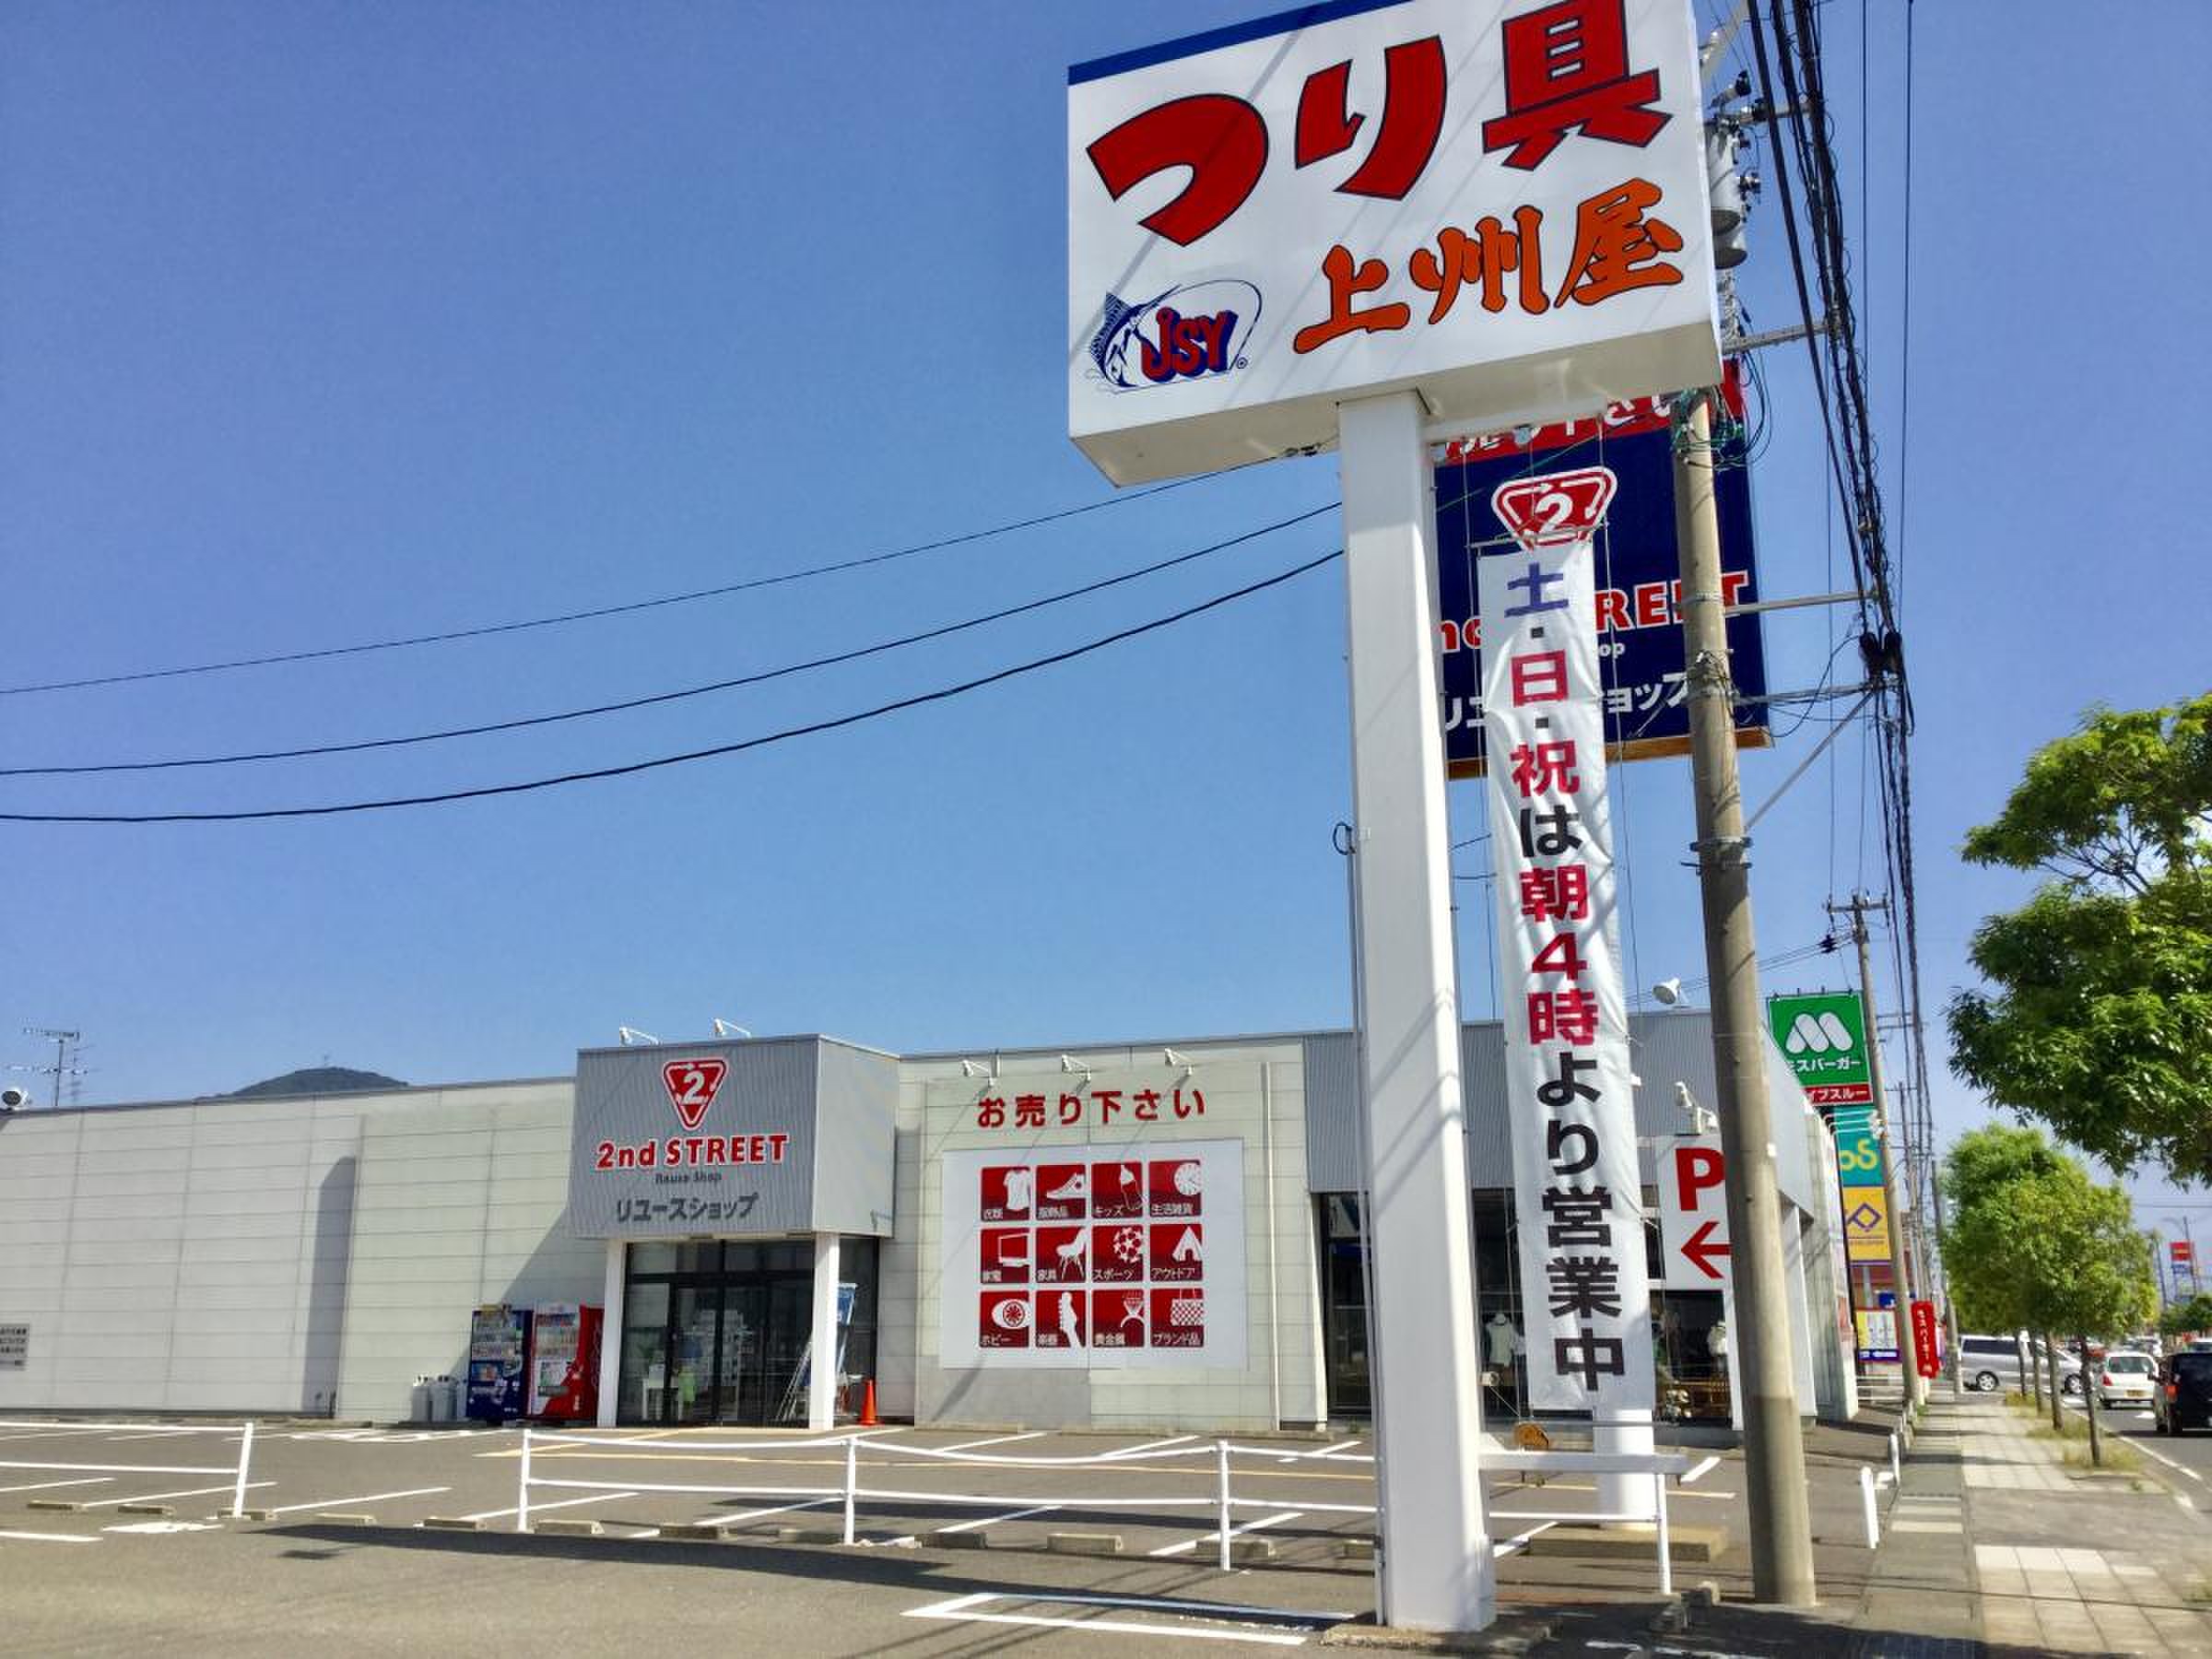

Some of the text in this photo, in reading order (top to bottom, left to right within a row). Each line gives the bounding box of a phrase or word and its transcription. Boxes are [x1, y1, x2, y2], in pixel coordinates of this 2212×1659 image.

[1086, 0, 1673, 247] つり具
[1292, 177, 1684, 355] 上州屋
[977, 1088, 1206, 1129] お売り下さい
[596, 1134, 789, 1170] 2nd STREET
[1676, 1147, 1724, 1211] P
[616, 1193, 759, 1222] リユースショップ
